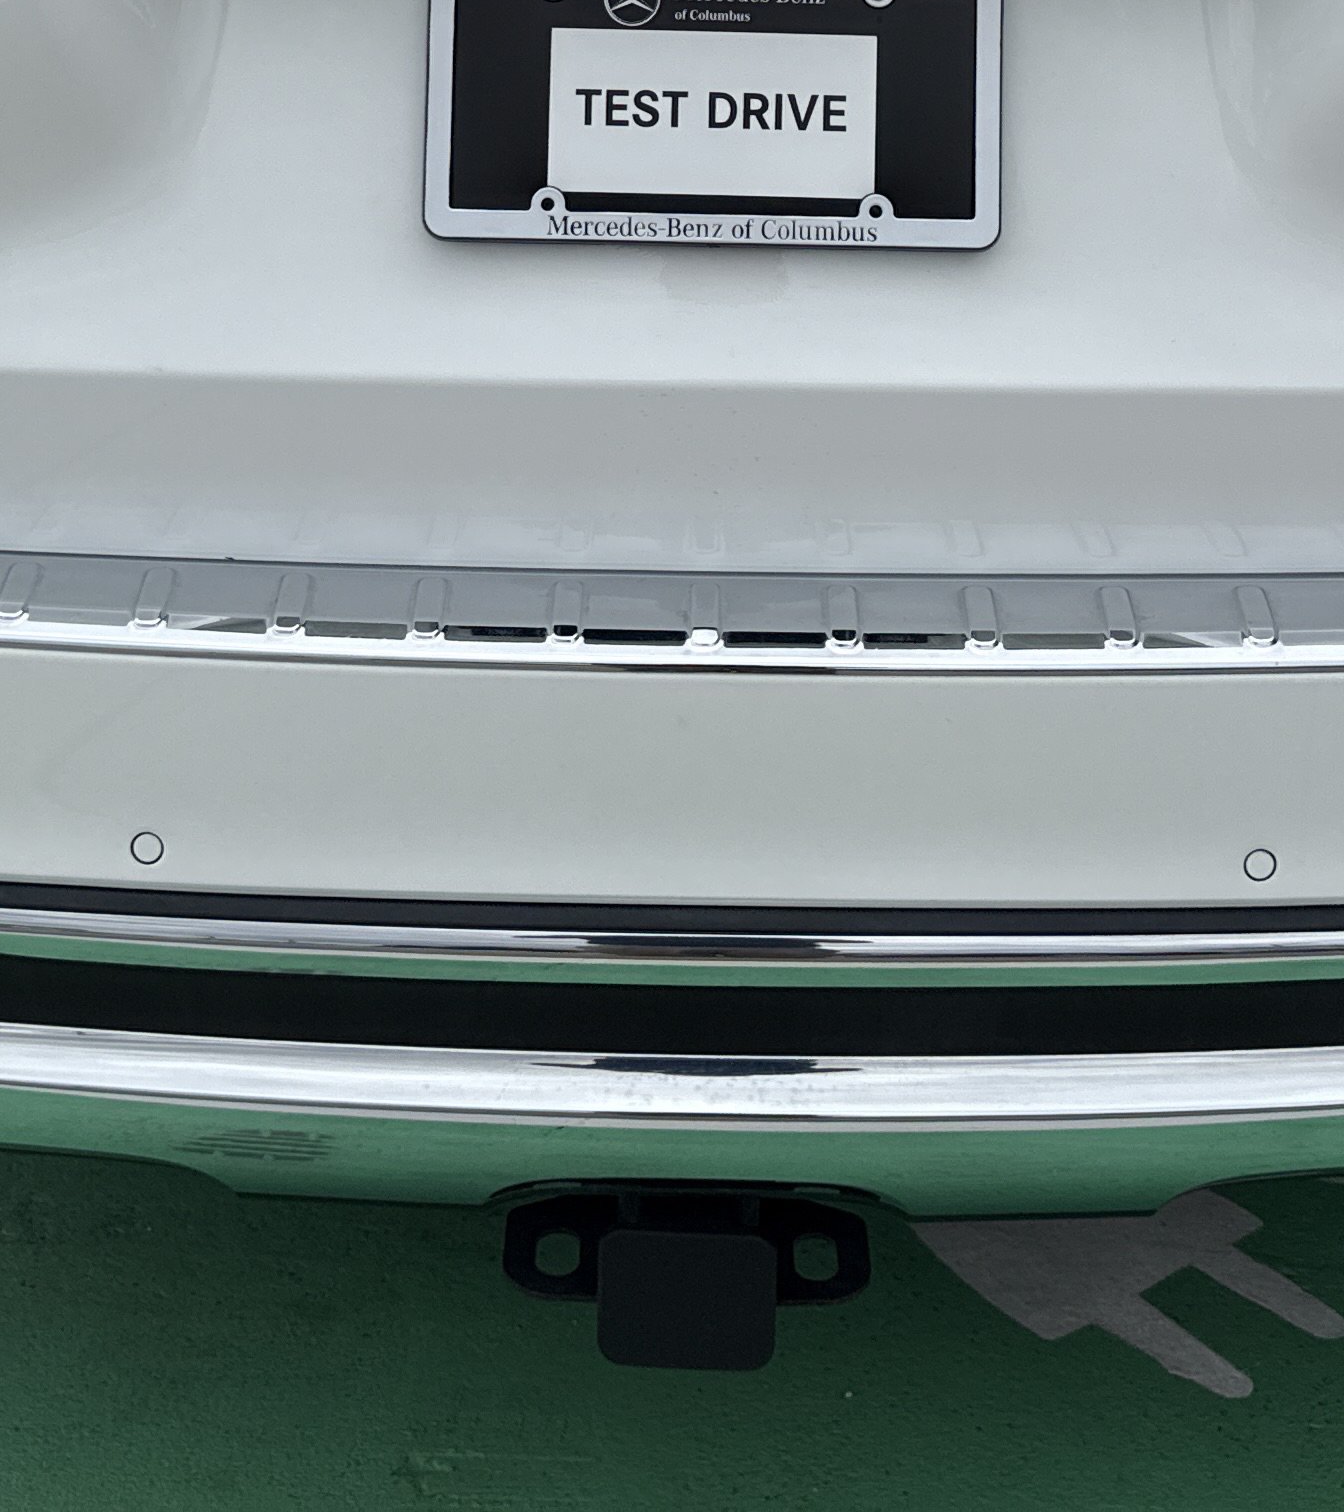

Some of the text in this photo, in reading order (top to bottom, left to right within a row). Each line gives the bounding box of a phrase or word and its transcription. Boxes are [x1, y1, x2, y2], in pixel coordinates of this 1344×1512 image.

[674, 9, 751, 23] of Columbus
[575, 88, 848, 132] TEST DRIVE
[546, 216, 878, 243] Mercedes-Benz of Columbus
